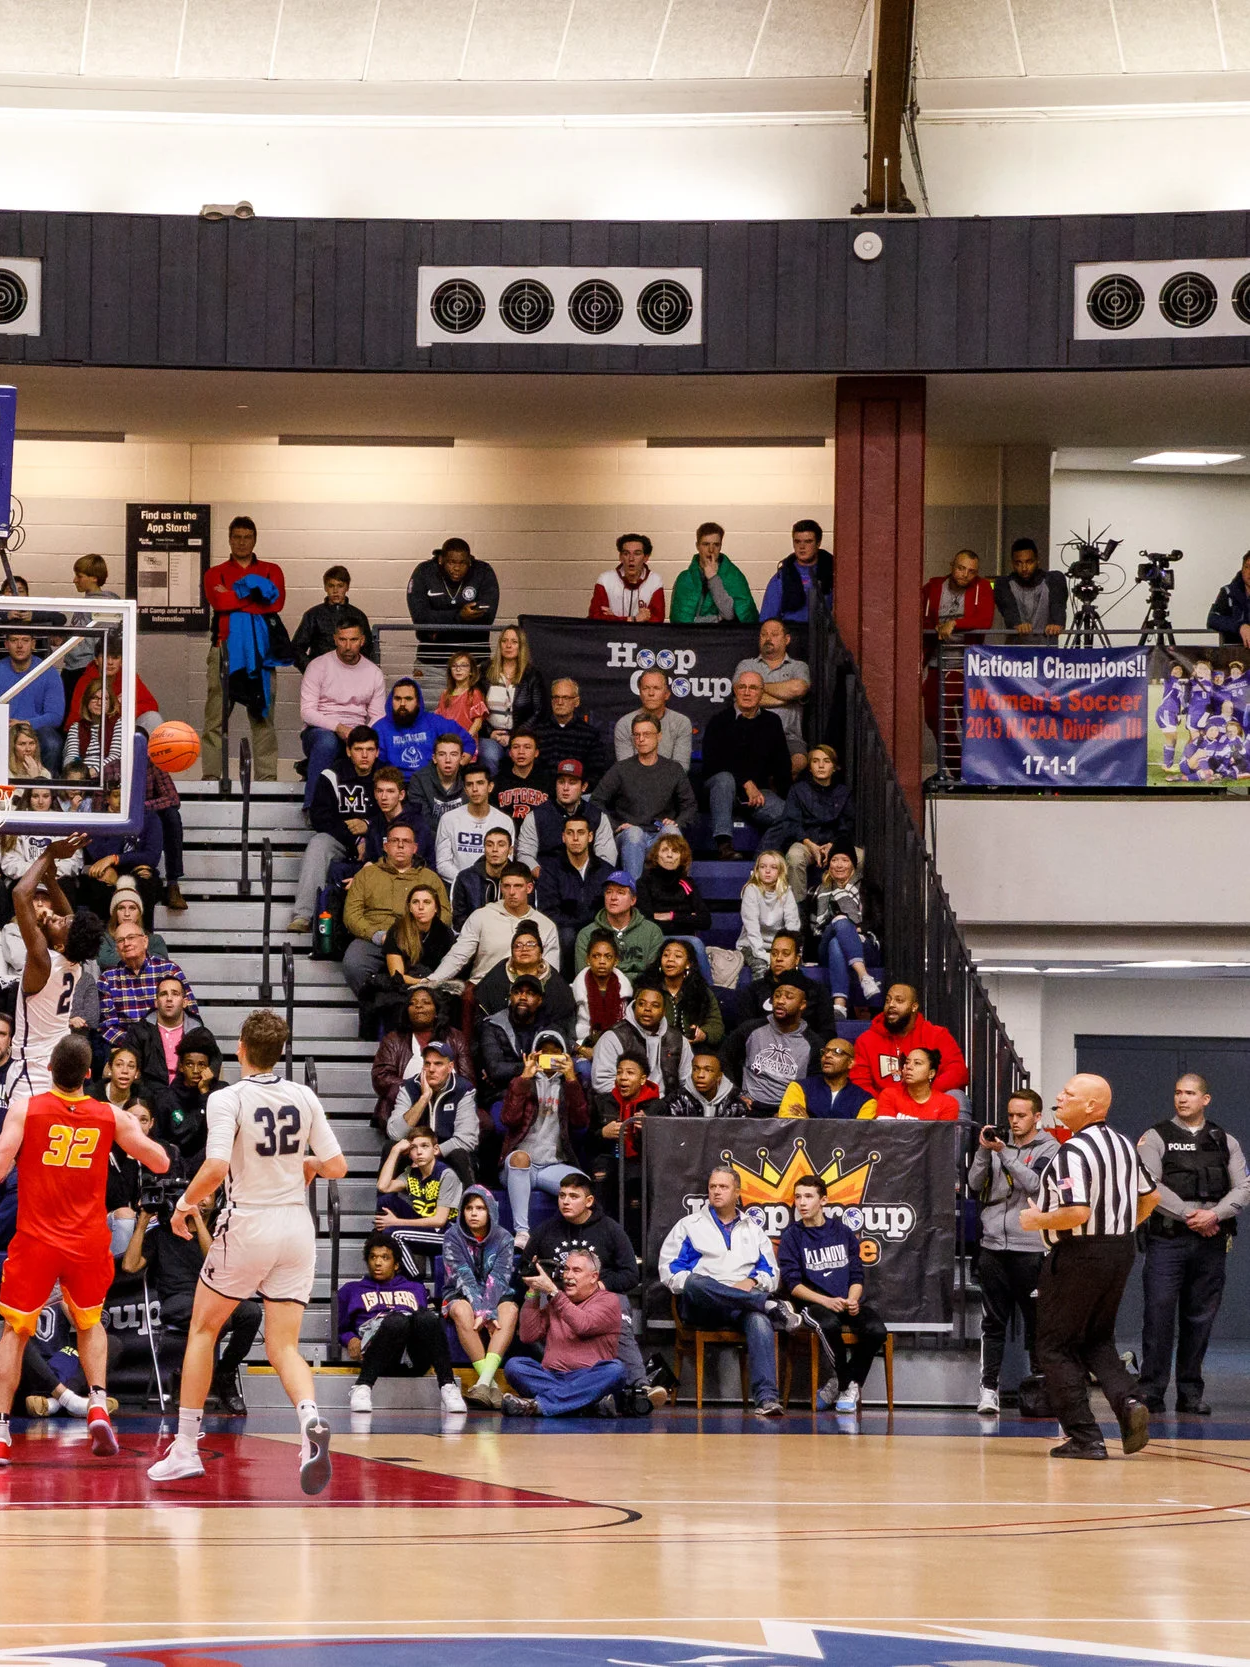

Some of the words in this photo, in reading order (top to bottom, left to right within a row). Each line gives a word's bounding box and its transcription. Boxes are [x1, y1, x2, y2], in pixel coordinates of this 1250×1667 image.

[141, 510, 159, 520] Find
[161, 512, 171, 520] us
[173, 511, 181, 520] in
[184, 511, 197, 520] the
[146, 523, 164, 533] App
[165, 523, 191, 533] Store!
[149, 607, 166, 615] Camp
[606, 642, 697, 675] Hoop
[967, 653, 1038, 679] National
[1043, 654, 1147, 684] Champions!!
[968, 687, 1061, 712] Women's
[1068, 689, 1143, 712] Soccer
[965, 716, 1003, 739] 2013
[1006, 716, 1059, 741] NJCAA
[1062, 717, 1121, 741] Division
[1126, 717, 1143, 740] III
[1022, 755, 1077, 776] 17-1-1
[337, 785, 366, 813] M
[497, 787, 549, 807] RUTGERS
[457, 831, 484, 846] CB
[254, 1104, 301, 1157] 32
[42, 1124, 101, 1169] 32
[1168, 1142, 1197, 1151] POLICE
